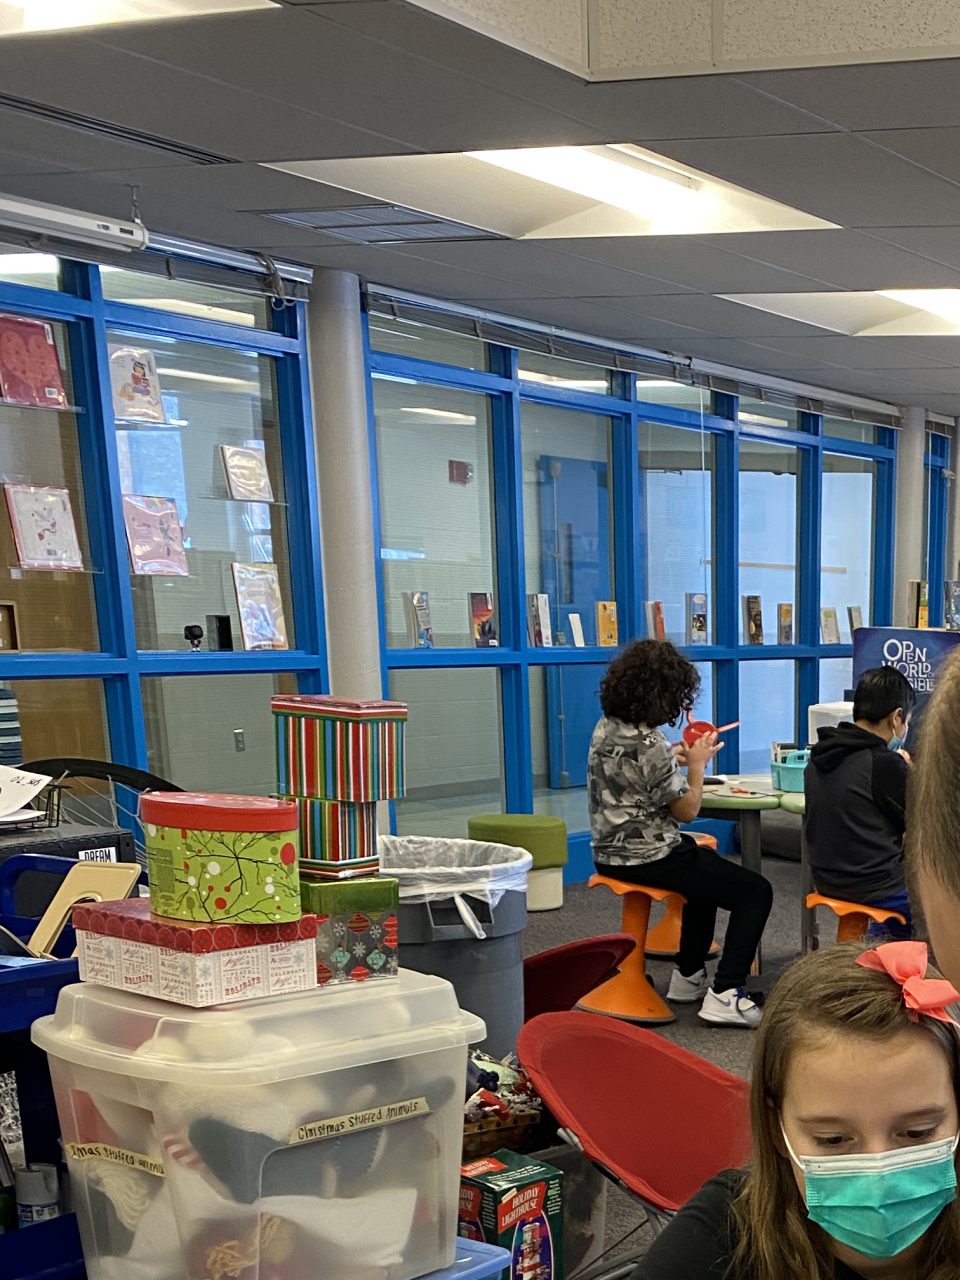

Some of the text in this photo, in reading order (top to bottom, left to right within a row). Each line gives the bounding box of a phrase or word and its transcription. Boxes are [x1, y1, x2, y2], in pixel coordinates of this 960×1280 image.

[883, 638, 927, 663] OPEN
[84, 848, 112, 862] DREAM
[121, 940, 151, 951] CELEBRATE
[222, 948, 259, 957] CELEBRATE
[86, 959, 116, 970] CELEBRATE
[270, 968, 306, 977] CELEBRATE
[124, 974, 154, 985] HOLIDAYS
[160, 976, 192, 987] CELEBRATE
[224, 976, 261, 996] HOLIDAYS
[512, 1187, 539, 1208] HOLIDAY
[501, 1199, 538, 1227] LIGHTHOUSE
